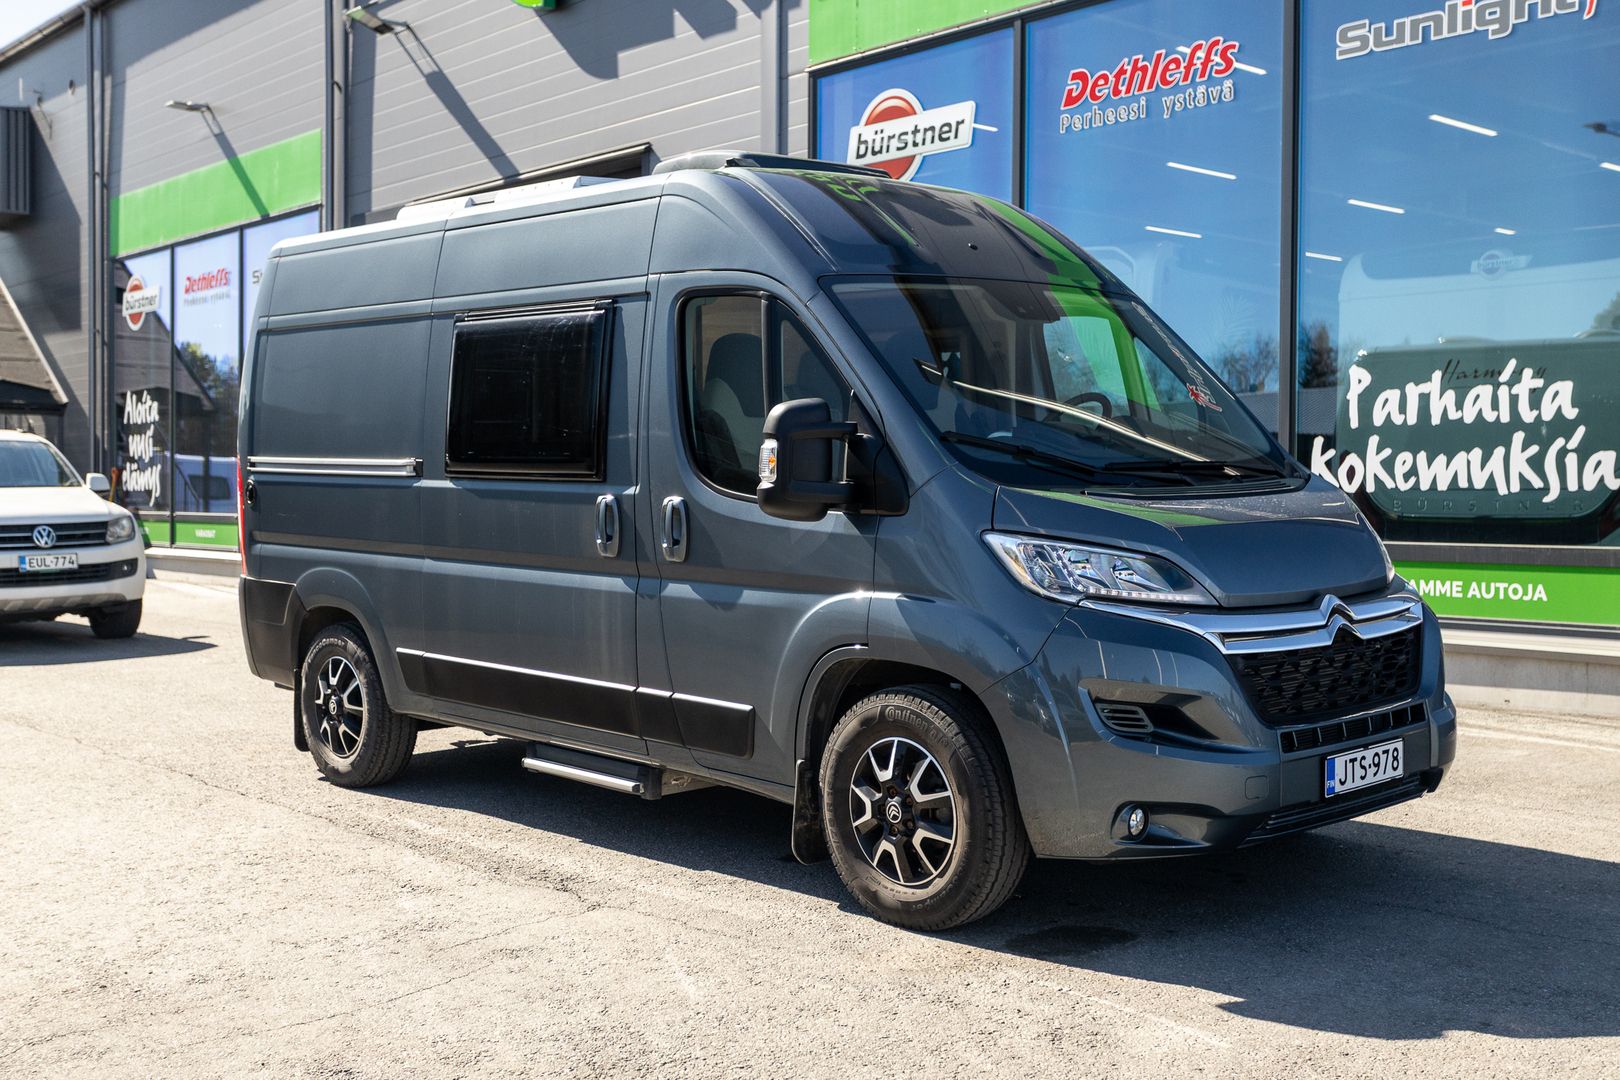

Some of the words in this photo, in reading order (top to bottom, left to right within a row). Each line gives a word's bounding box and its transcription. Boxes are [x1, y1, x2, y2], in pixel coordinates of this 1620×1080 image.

[1061, 36, 1239, 110] Dethleffs
[1059, 97, 1147, 134] Perheesi
[1162, 79, 1235, 119] ystävä
[855, 118, 965, 159] bürstner
[124, 294, 158, 311] bürstner
[123, 390, 160, 425] Aloita
[1347, 358, 1579, 429] Parhaita
[1467, 582, 1547, 602] AUTOJA
[1338, 746, 1400, 786] JTS-978
